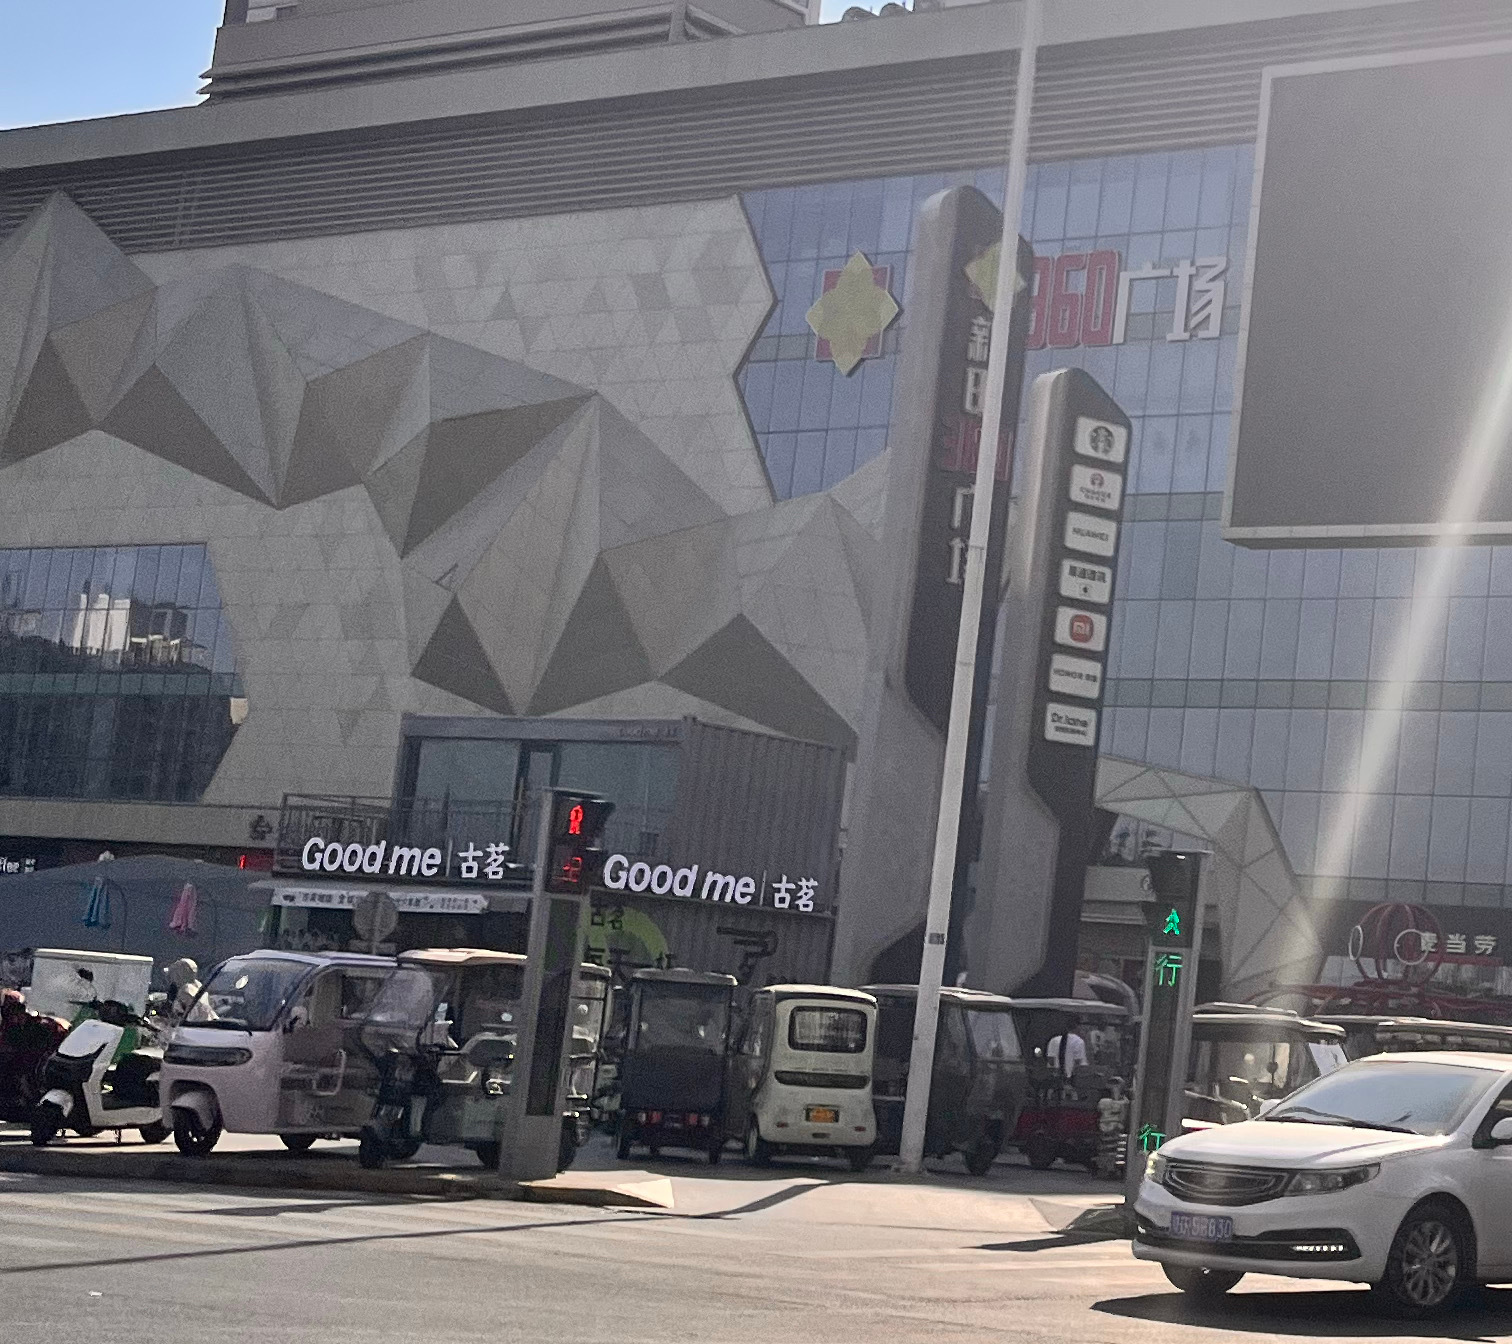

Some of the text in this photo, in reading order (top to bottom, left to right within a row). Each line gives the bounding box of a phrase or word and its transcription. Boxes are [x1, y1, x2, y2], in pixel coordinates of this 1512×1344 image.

[302, 837, 387, 874] Good
[388, 845, 442, 877] me
[457, 842, 509, 879] 古茗
[603, 854, 699, 898] Good
[701, 870, 756, 904] me
[772, 874, 819, 912] 古茗
[1155, 954, 1183, 986] 行
